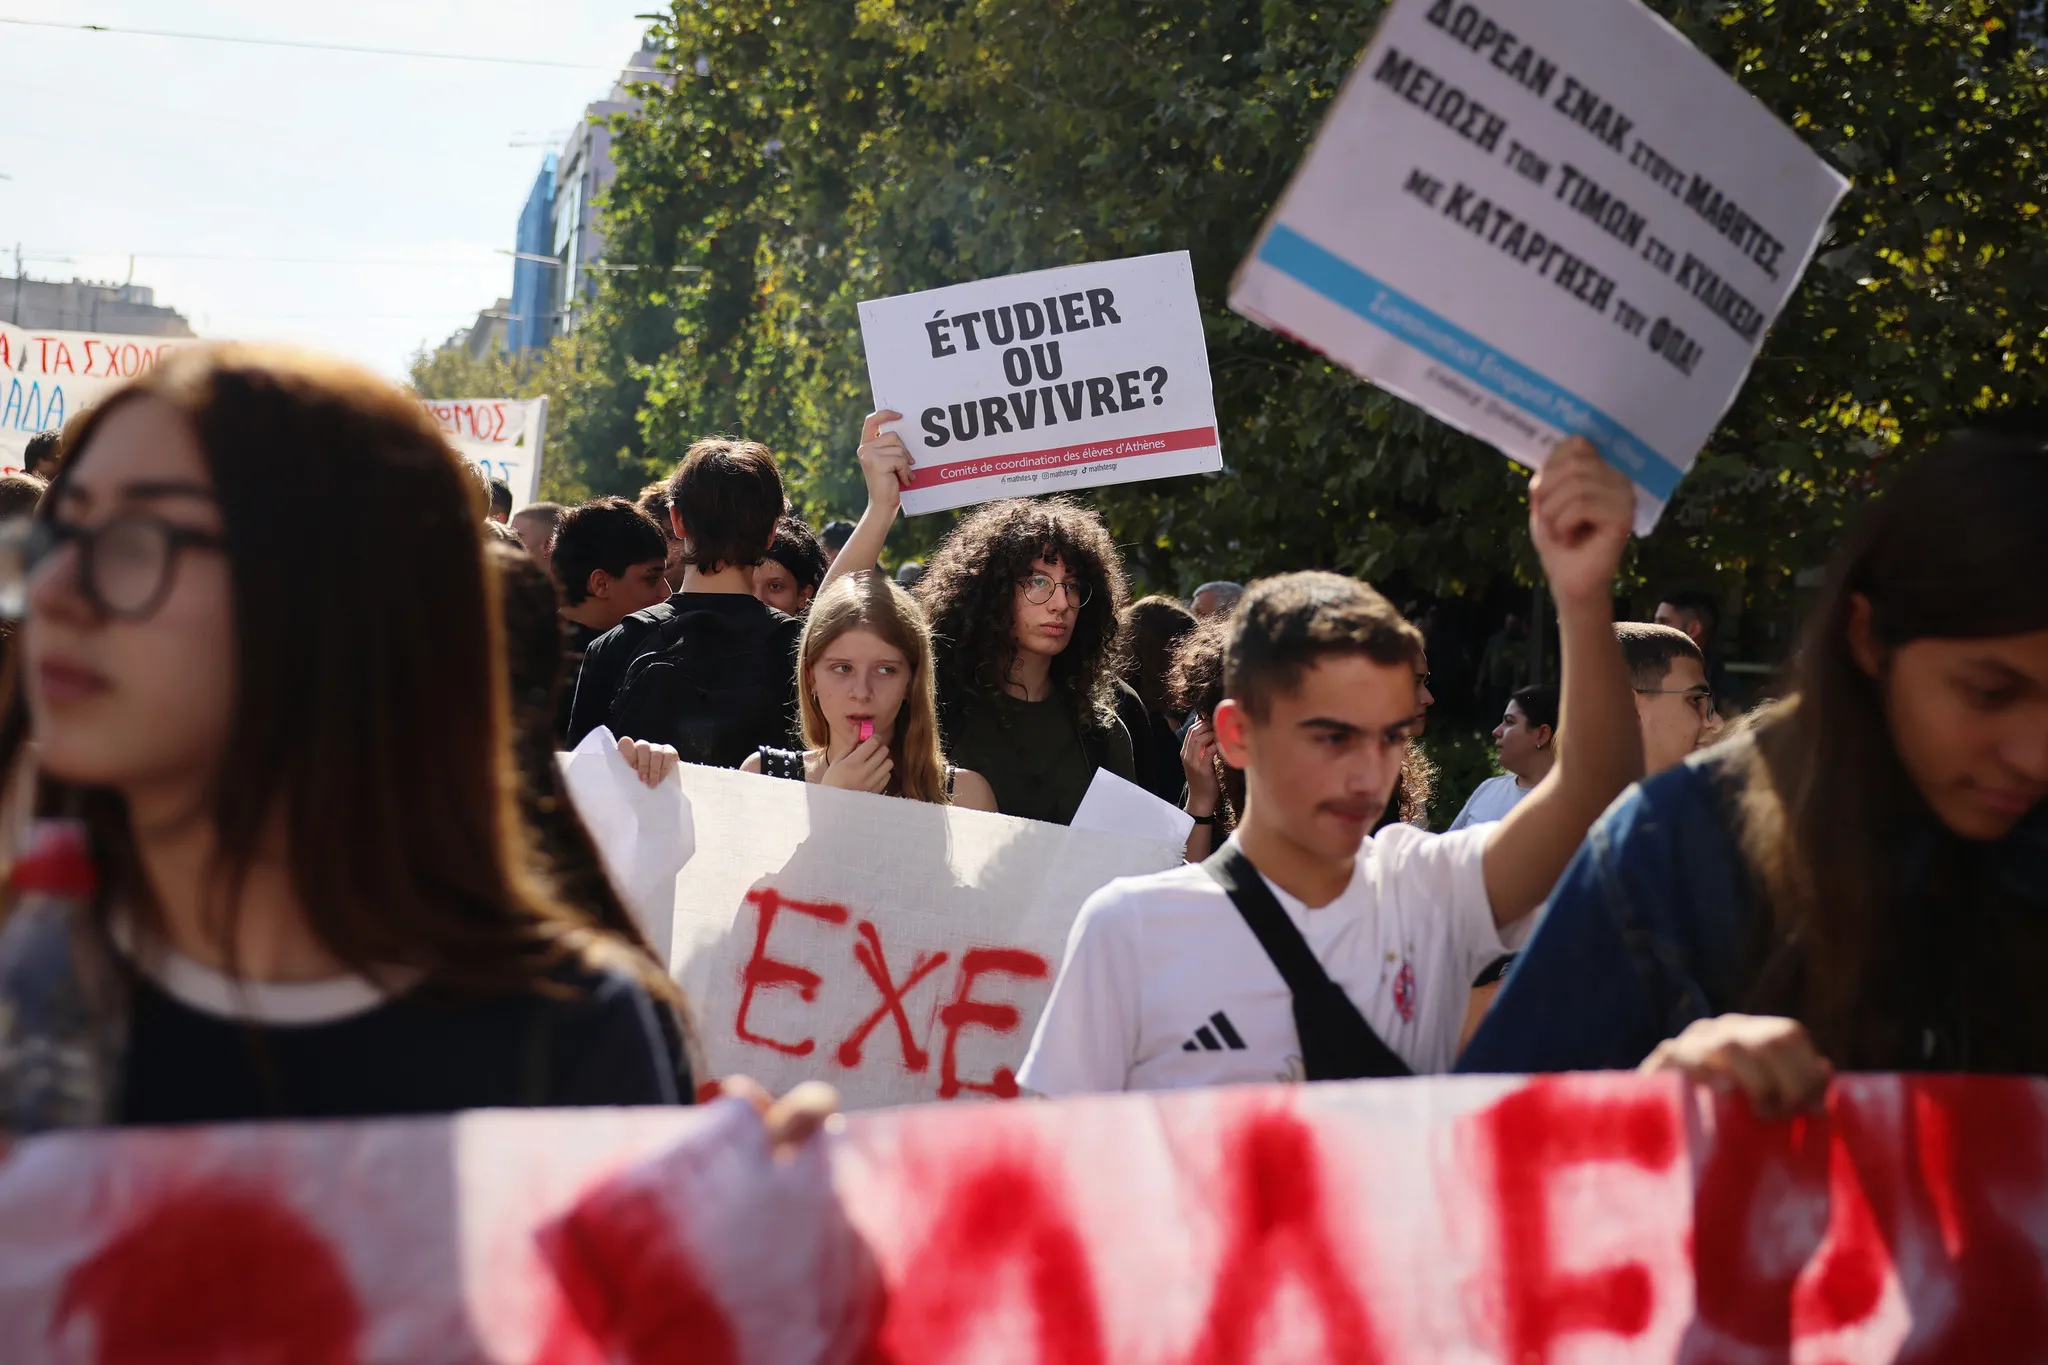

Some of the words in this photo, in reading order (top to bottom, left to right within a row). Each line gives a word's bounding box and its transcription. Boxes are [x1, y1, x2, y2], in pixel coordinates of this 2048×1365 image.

[1552, 75, 1634, 153] ΣΝΑΚ
[1373, 48, 1508, 154] ΜΕΙΩΣΗ
[1554, 162, 1647, 249] ΤΙΜΩΝ
[1677, 252, 1767, 346] ΚΥΛΙΚΕΙΑ
[1441, 181, 1617, 313] ΚΑΤΑΡΓΗΣΗ
[925, 287, 1121, 358] ÉTUDIER
[1002, 341, 1063, 387] OU
[0, 378, 64, 432] ΑΔΑ
[920, 366, 1168, 447] SURVIVRE?
[940, 464, 978, 479] Comité
[980, 462, 993, 473] de
[996, 454, 1061, 471] coordination
[1063, 451, 1081, 462] des
[1082, 444, 1114, 459] élèves
[1115, 438, 1166, 455] d'Athènes
[1006, 472, 1038, 483] mathites.gr
[1049, 467, 1078, 478] mathitesgr
[1088, 462, 1118, 473] mathitesgr
